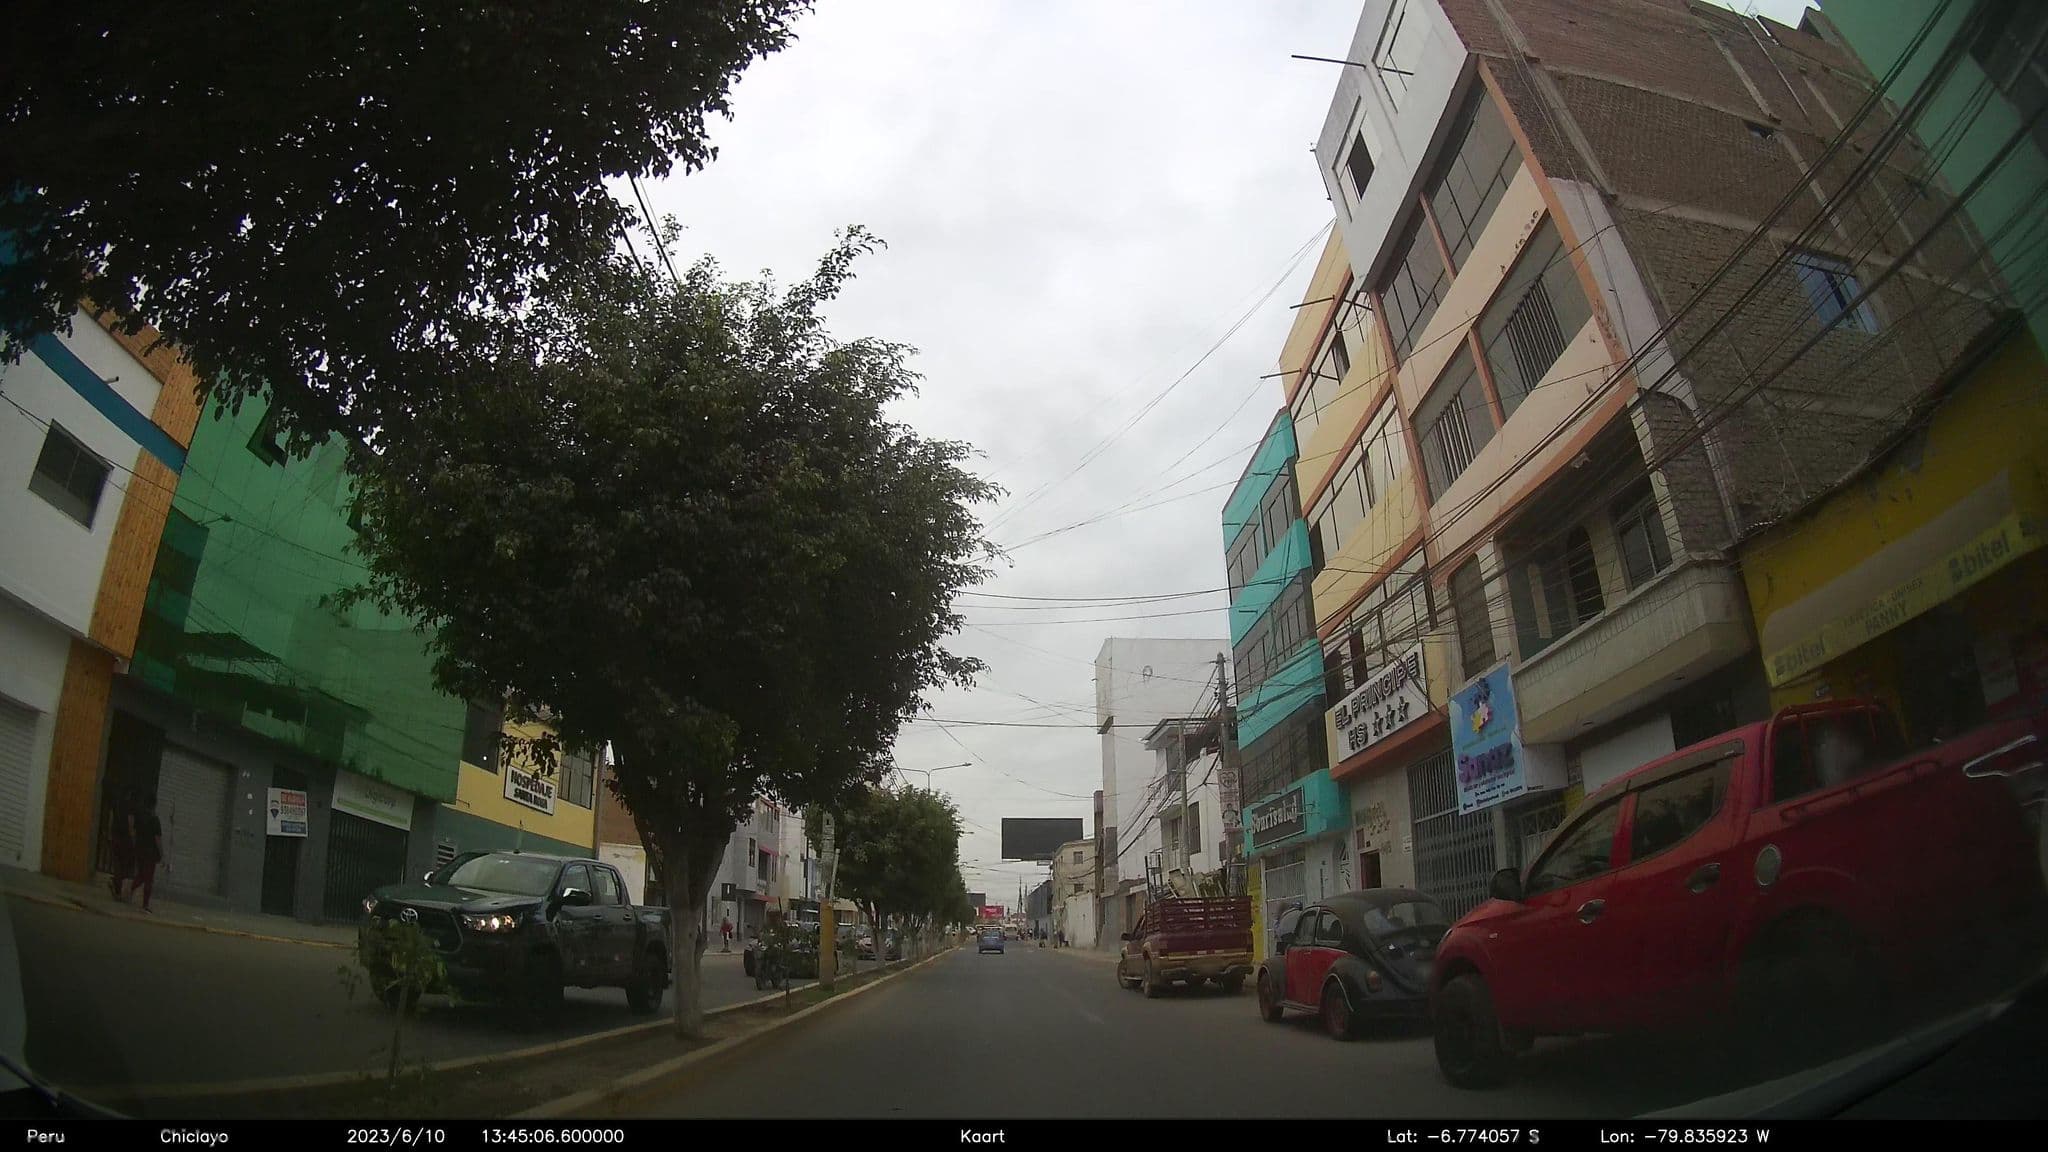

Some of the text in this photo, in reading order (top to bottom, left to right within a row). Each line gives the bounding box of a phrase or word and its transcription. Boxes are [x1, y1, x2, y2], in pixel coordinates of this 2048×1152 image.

[1964, 529, 2011, 577] bitel
[1335, 652, 1420, 730] EL PRINCIPE
[1348, 722, 1369, 751] HS
[511, 769, 553, 799] HOSPEDAJE
